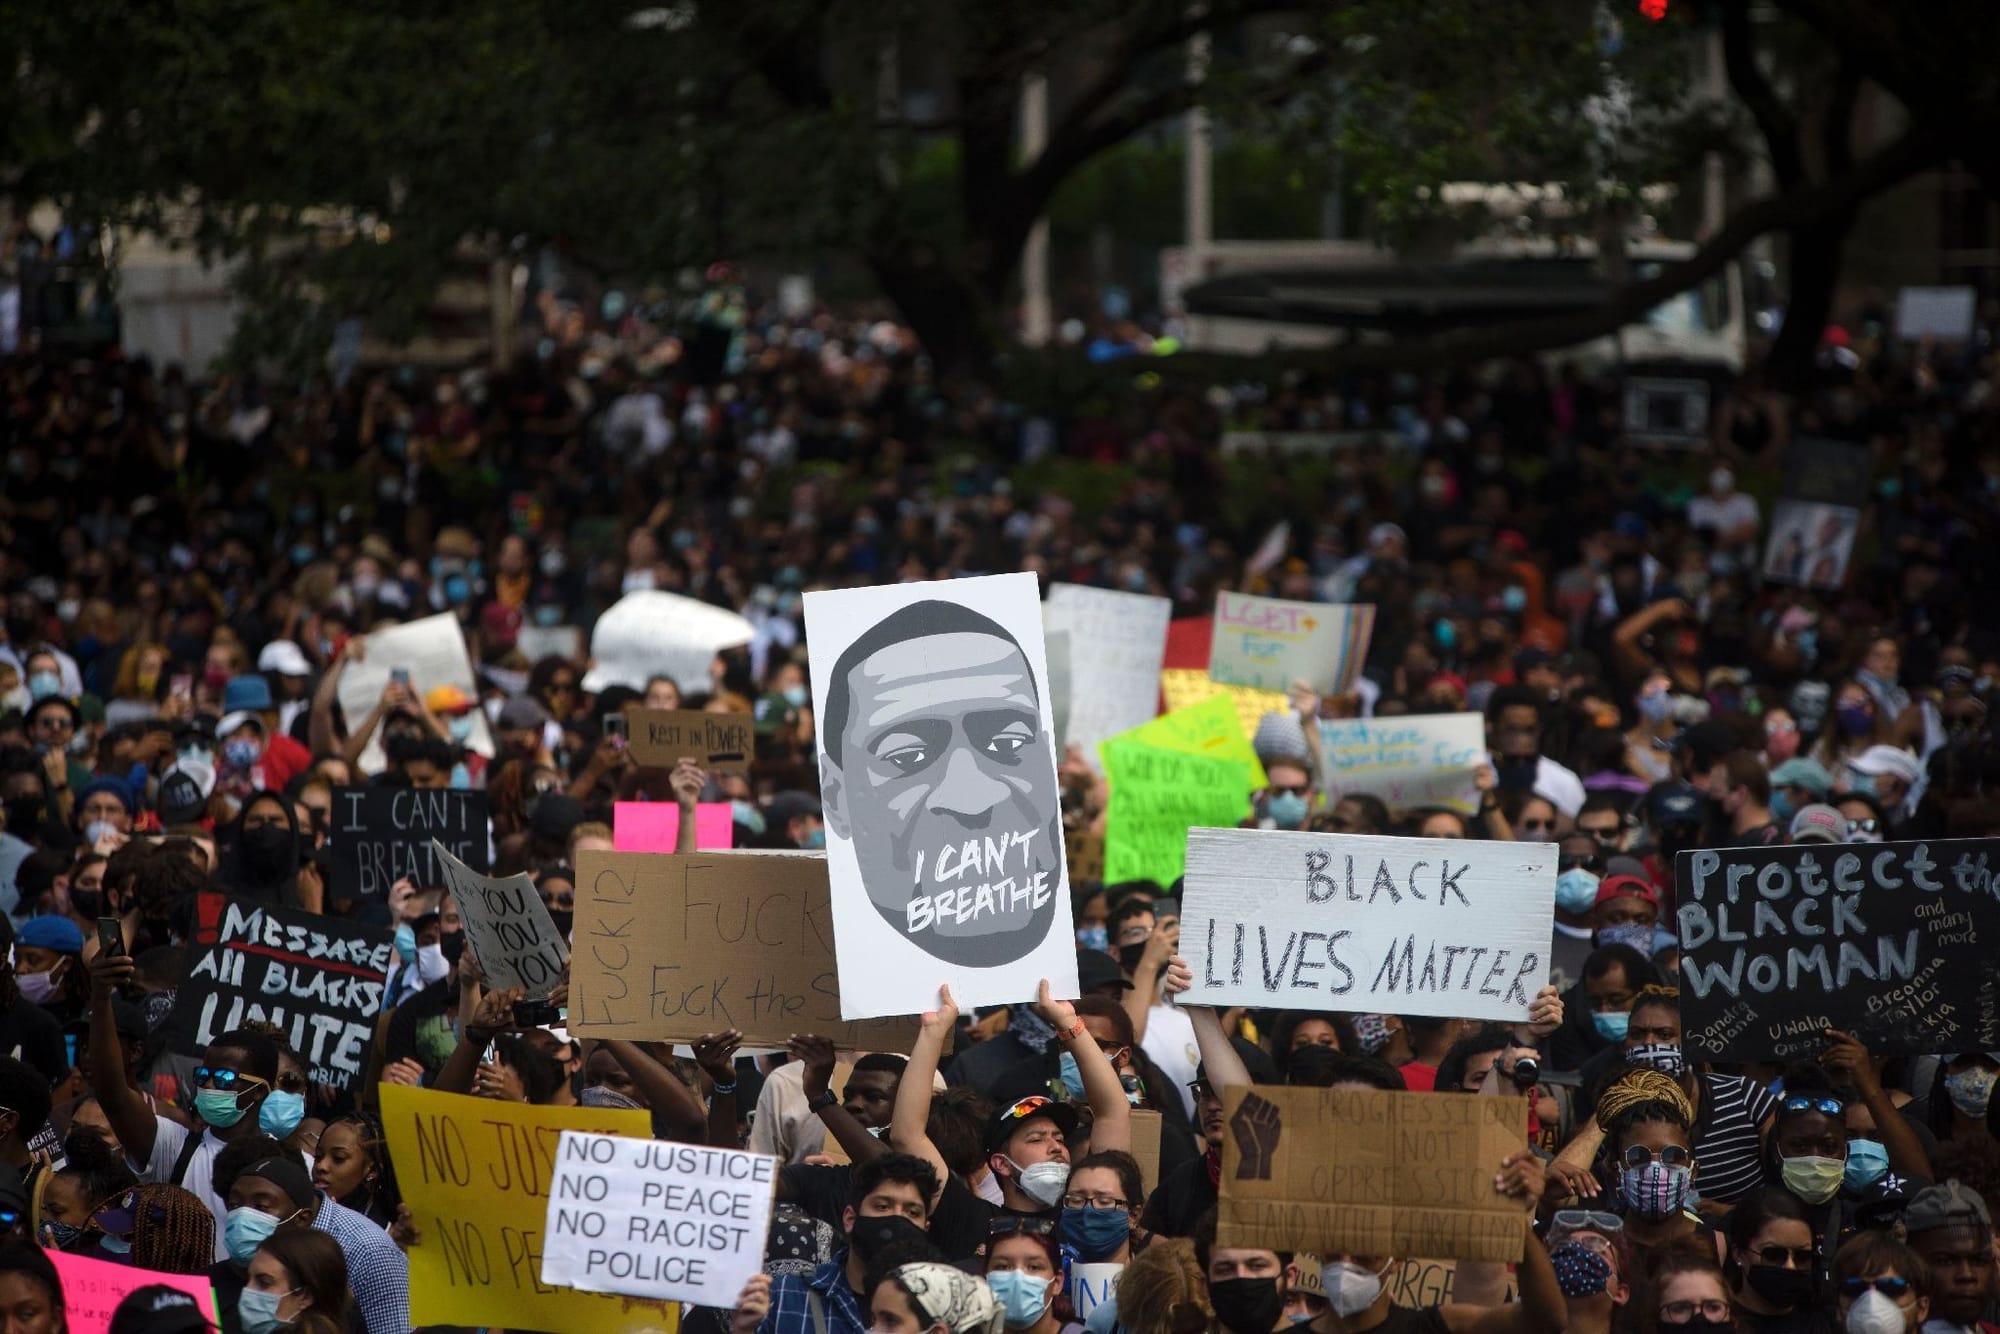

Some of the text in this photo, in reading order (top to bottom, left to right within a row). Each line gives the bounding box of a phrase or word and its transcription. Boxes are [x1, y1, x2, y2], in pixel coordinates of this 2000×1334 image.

[689, 730, 702, 746] IN
[705, 719, 749, 752] POWER
[342, 790, 473, 832] I CANT
[357, 840, 473, 895] BREAT
[914, 850, 925, 884] I
[935, 828, 1040, 883] CAN'T
[1304, 849, 1471, 906] BLACK
[1691, 843, 1943, 904] Protect
[592, 869, 636, 905] 12
[906, 871, 1051, 934] BREATHE
[1914, 896, 1946, 919] and
[1676, 892, 1869, 950] BLACK
[1927, 910, 1974, 933] many
[1936, 929, 1978, 947] more
[1204, 918, 1539, 1007] LIVES MATTER
[1680, 928, 1920, 1000] WOMAN
[1866, 955, 1947, 1014] Breonna
[260, 960, 385, 1018] BLACKS
[745, 976, 805, 1021] the
[1879, 981, 1940, 1026] Taylor
[1686, 1000, 1750, 1047] Sandra
[1705, 1009, 1759, 1055] Bland
[1935, 1018, 1961, 1044] oyd
[307, 1068, 350, 1090] #BLM
[415, 1112, 470, 1188] NO
[566, 1134, 616, 1164] NO
[634, 1145, 775, 1184] JUSTICE
[1402, 1129, 1456, 1163] NOT
[559, 1174, 752, 1220] NO PEACE
[1311, 1165, 1488, 1203] OPPRESSIO
[435, 1217, 491, 1288] NO
[555, 1209, 750, 1253] NO RACIST
[585, 1250, 707, 1286] POLICE
